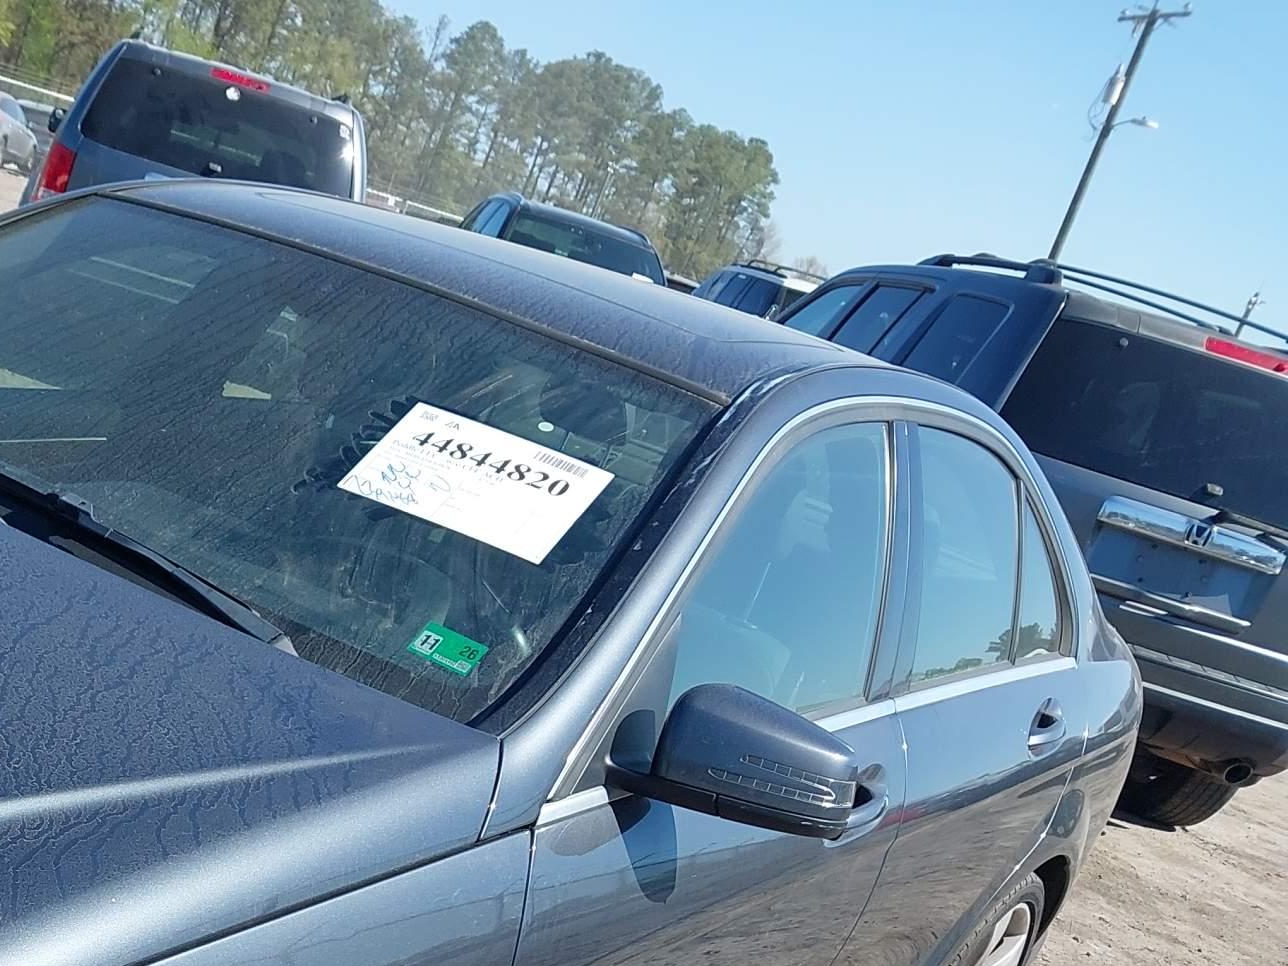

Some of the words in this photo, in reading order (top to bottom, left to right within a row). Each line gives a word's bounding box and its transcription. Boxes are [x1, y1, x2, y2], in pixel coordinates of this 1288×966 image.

[412, 431, 570, 497] 44844820
[420, 633, 441, 651] 11
[459, 645, 479, 660] 26
